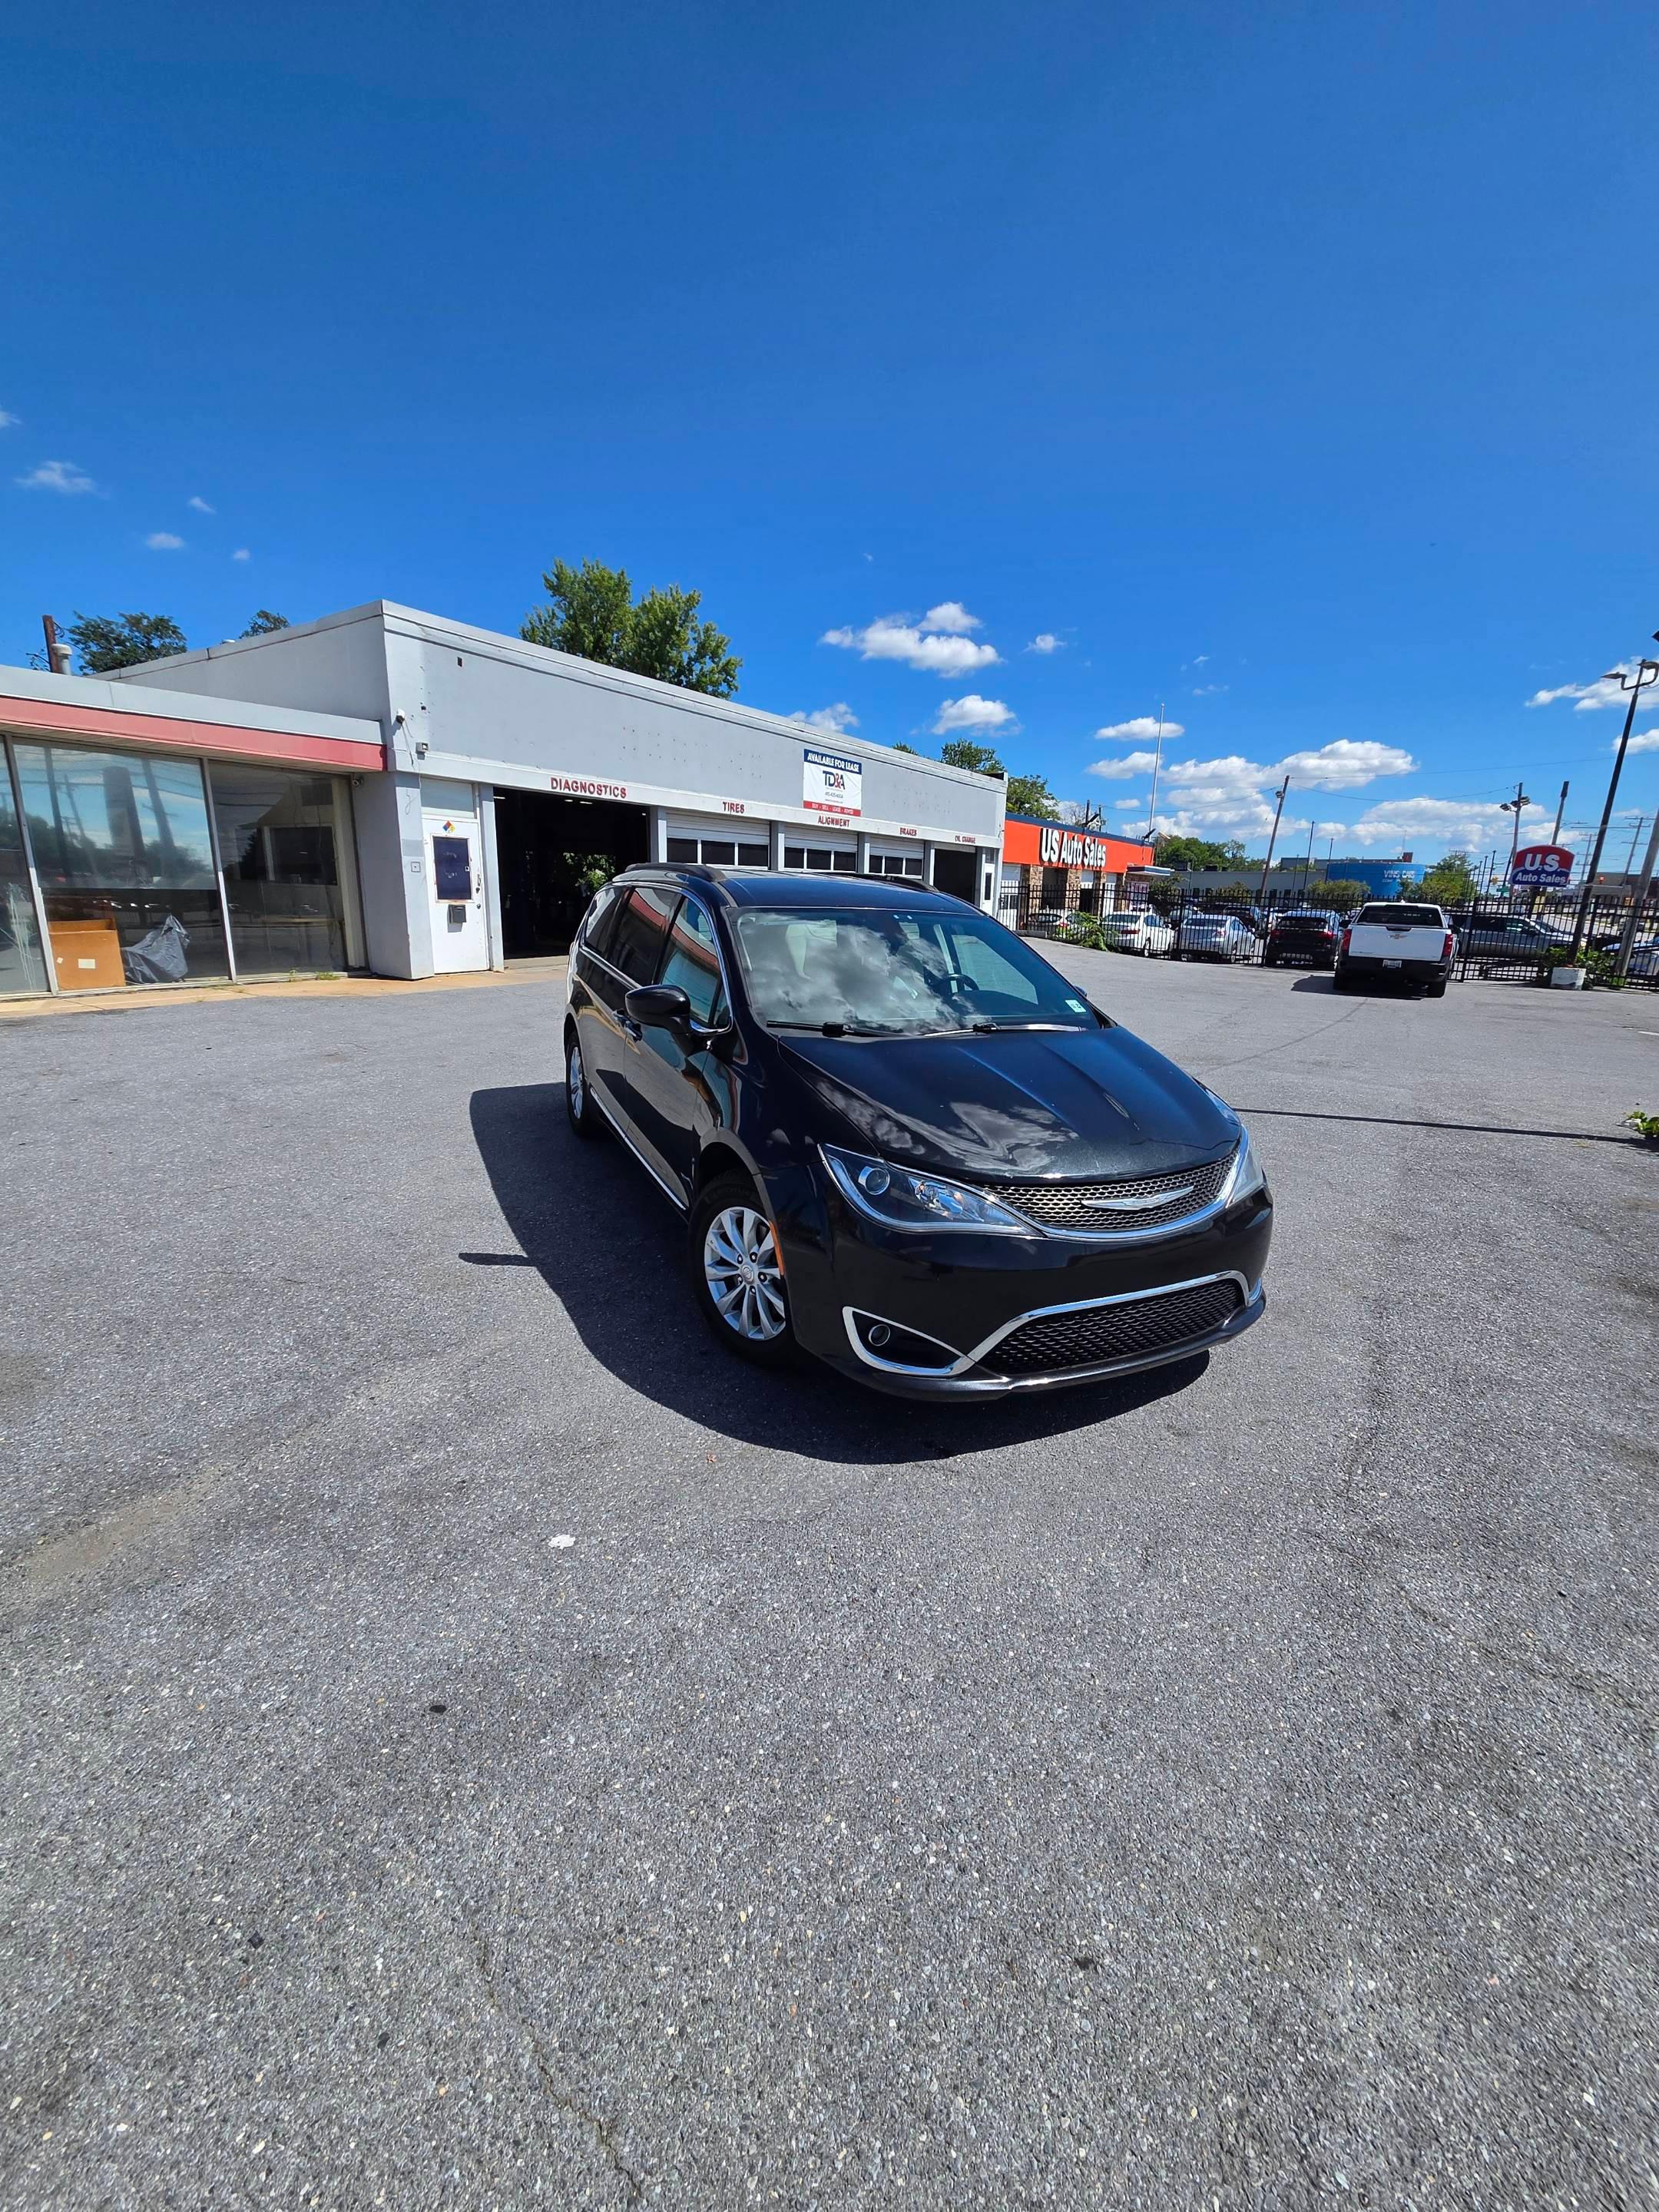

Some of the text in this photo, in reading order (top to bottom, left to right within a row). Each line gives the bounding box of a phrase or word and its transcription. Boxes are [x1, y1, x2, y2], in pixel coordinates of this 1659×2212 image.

[807, 753, 859, 772] AVAILABLE FOR LEASE
[550, 777, 627, 799] DIAGNOSTICS
[823, 770, 846, 790] TD&A
[723, 801, 745, 814] TIRES
[818, 815, 850, 827] ALIGNMENT
[899, 827, 917, 836] BRAKES
[1041, 827, 1106, 867] US Auto Sales
[1524, 853, 1561, 872] U.S.
[1515, 873, 1566, 883] Auto Sales
